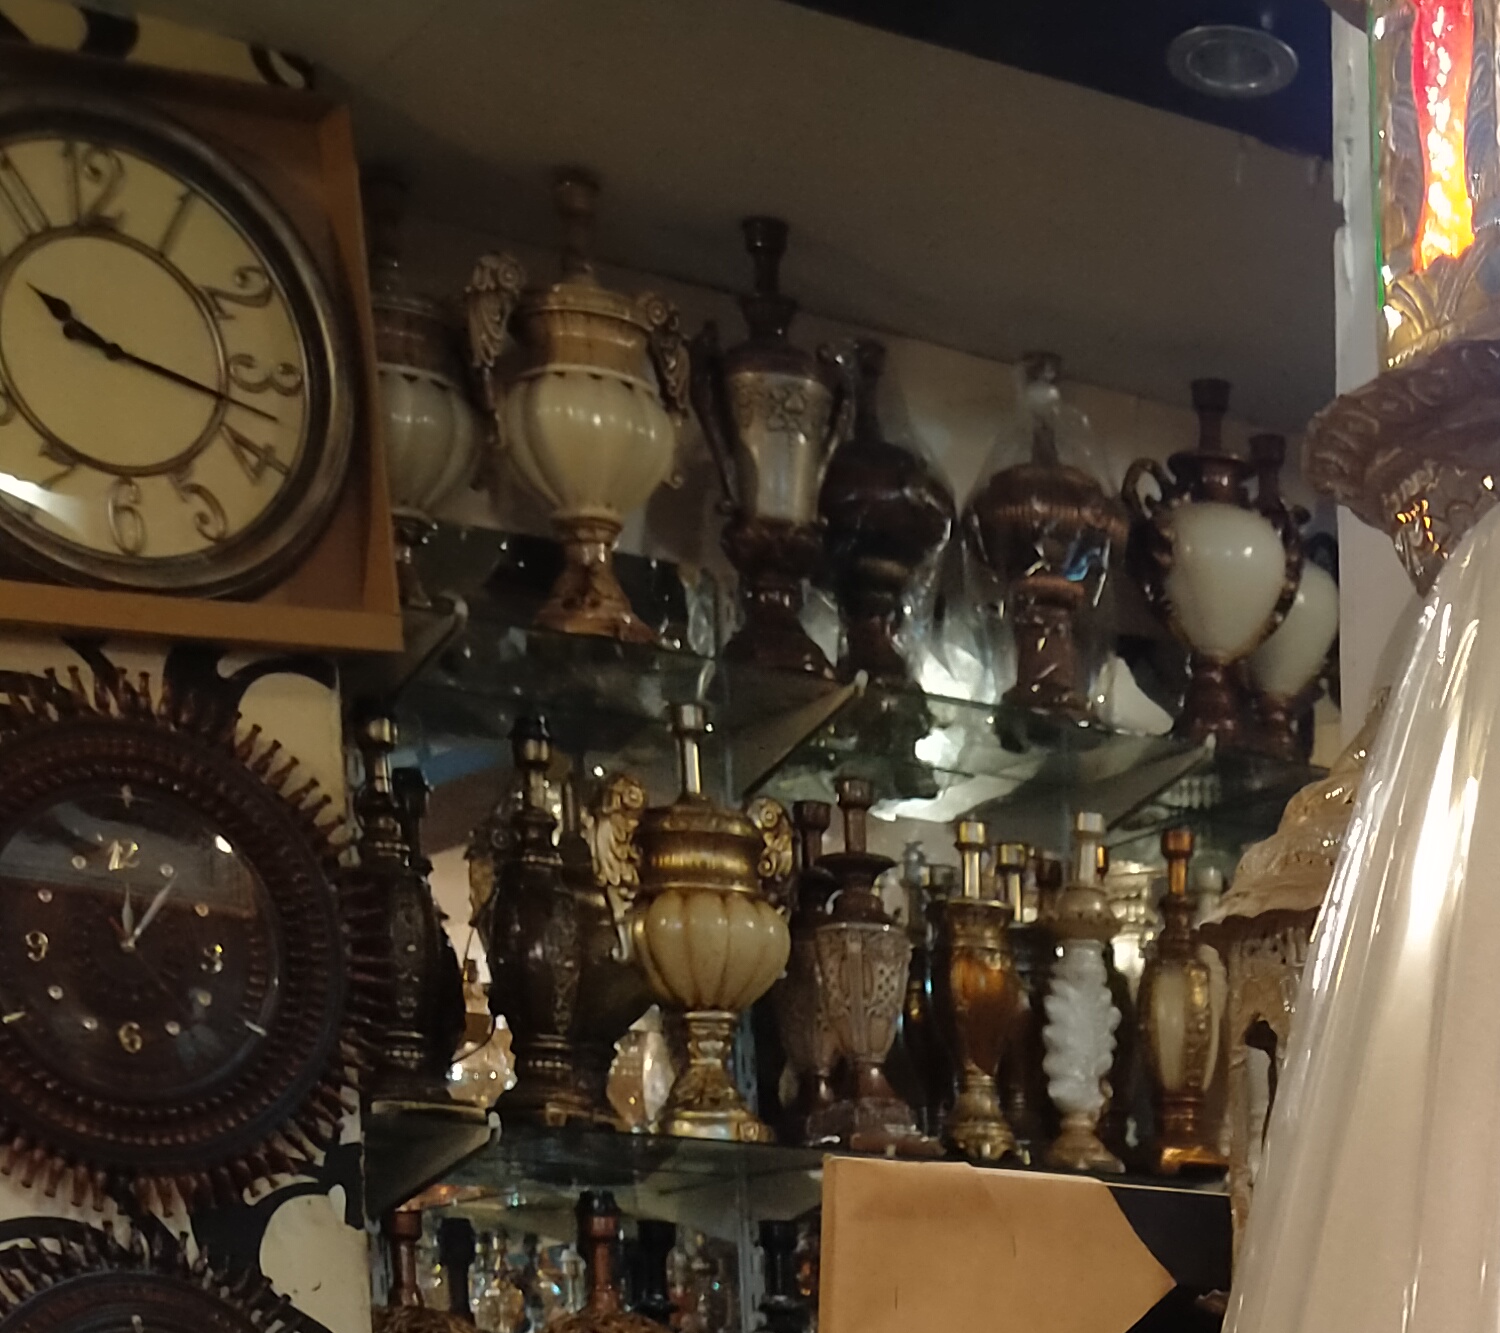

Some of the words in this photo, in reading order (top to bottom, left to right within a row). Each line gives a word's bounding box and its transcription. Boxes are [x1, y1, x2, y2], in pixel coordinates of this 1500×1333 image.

[199, 264, 274, 320] 2
[228, 352, 303, 397] 3
[218, 422, 292, 487] 4
[107, 477, 147, 558] 6
[169, 464, 229, 543] 5
[107, 839, 140, 871] 12
[25, 931, 49, 962] 9
[200, 943, 224, 974] 3
[117, 1021, 143, 1054] 6
